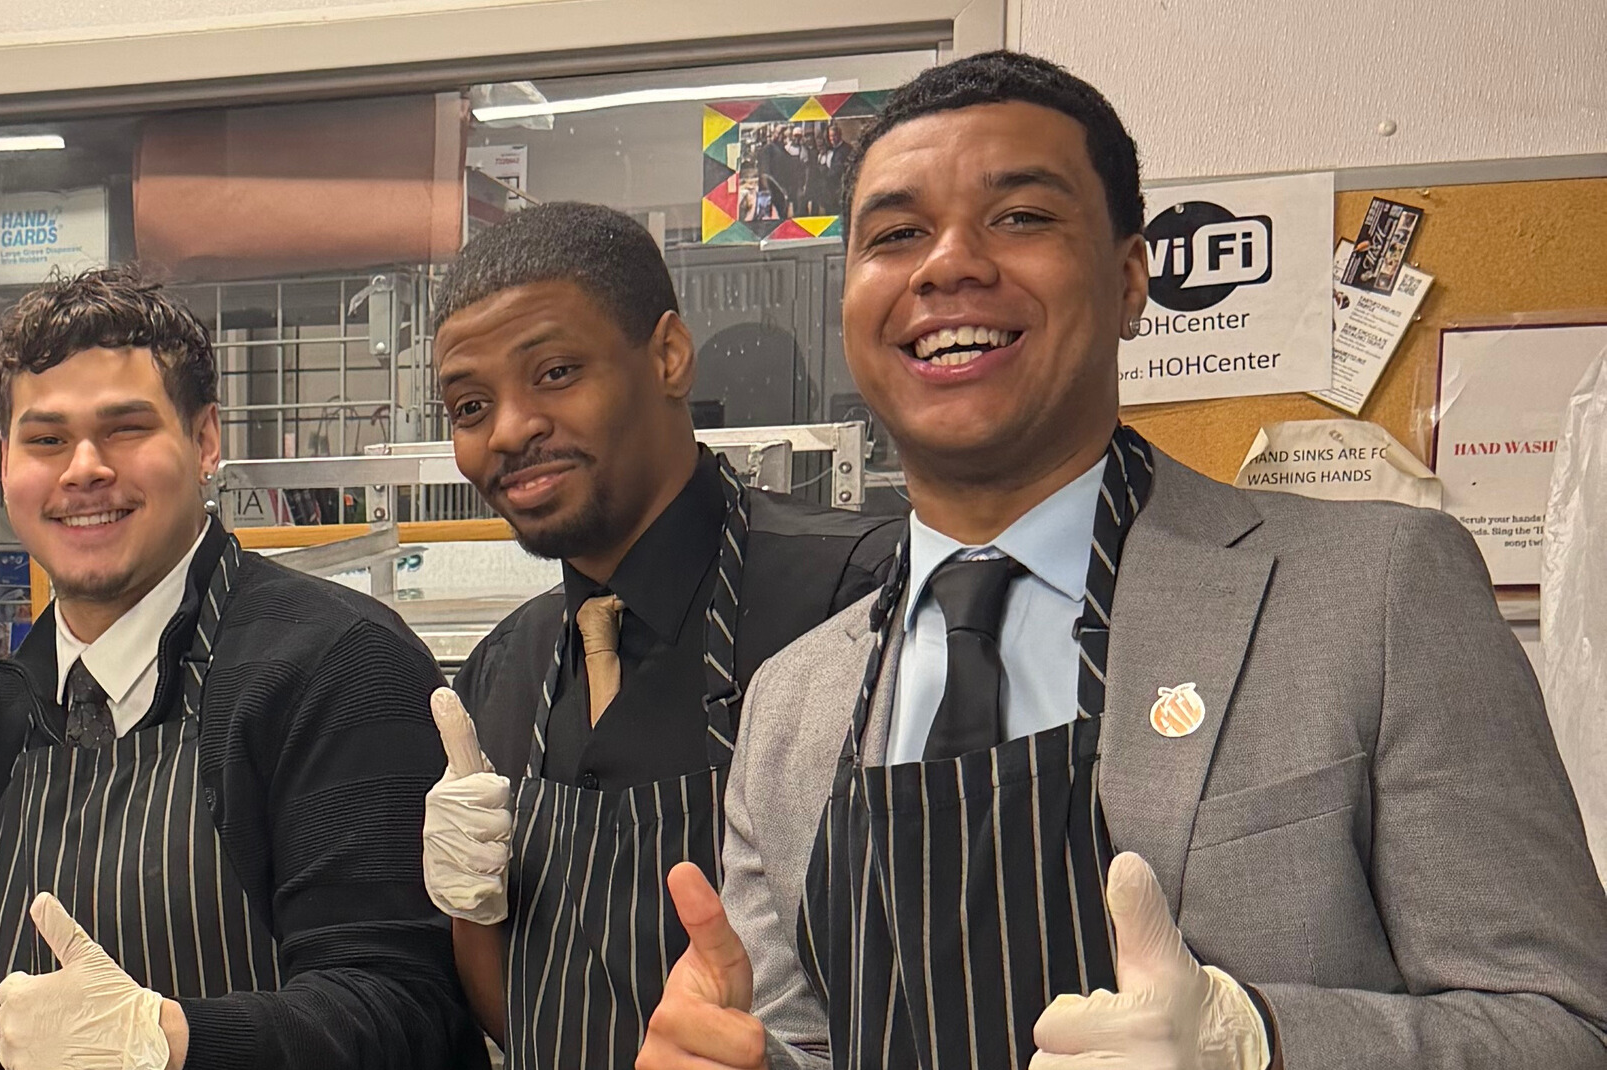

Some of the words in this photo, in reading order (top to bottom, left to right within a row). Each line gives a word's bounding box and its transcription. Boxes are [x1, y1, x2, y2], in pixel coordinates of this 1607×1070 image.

[0, 226, 58, 247] GARDS
[1137, 312, 1251, 337] OHCenter
[1149, 352, 1281, 378] HOHCenter
[1293, 449, 1334, 462] SINKS
[1337, 447, 1367, 460] ARE
[1454, 442, 1501, 456] HAND
[1504, 440, 1558, 454] WASH
[1247, 471, 1316, 486] WASHING
[1320, 469, 1372, 483] HANDS
[1488, 516, 1511, 526] your
[1512, 514, 1542, 523] hands
[1491, 527, 1514, 537] Sing
[1515, 526, 1531, 535] the
[1504, 539, 1527, 549] song
[1528, 538, 1544, 547] twi
